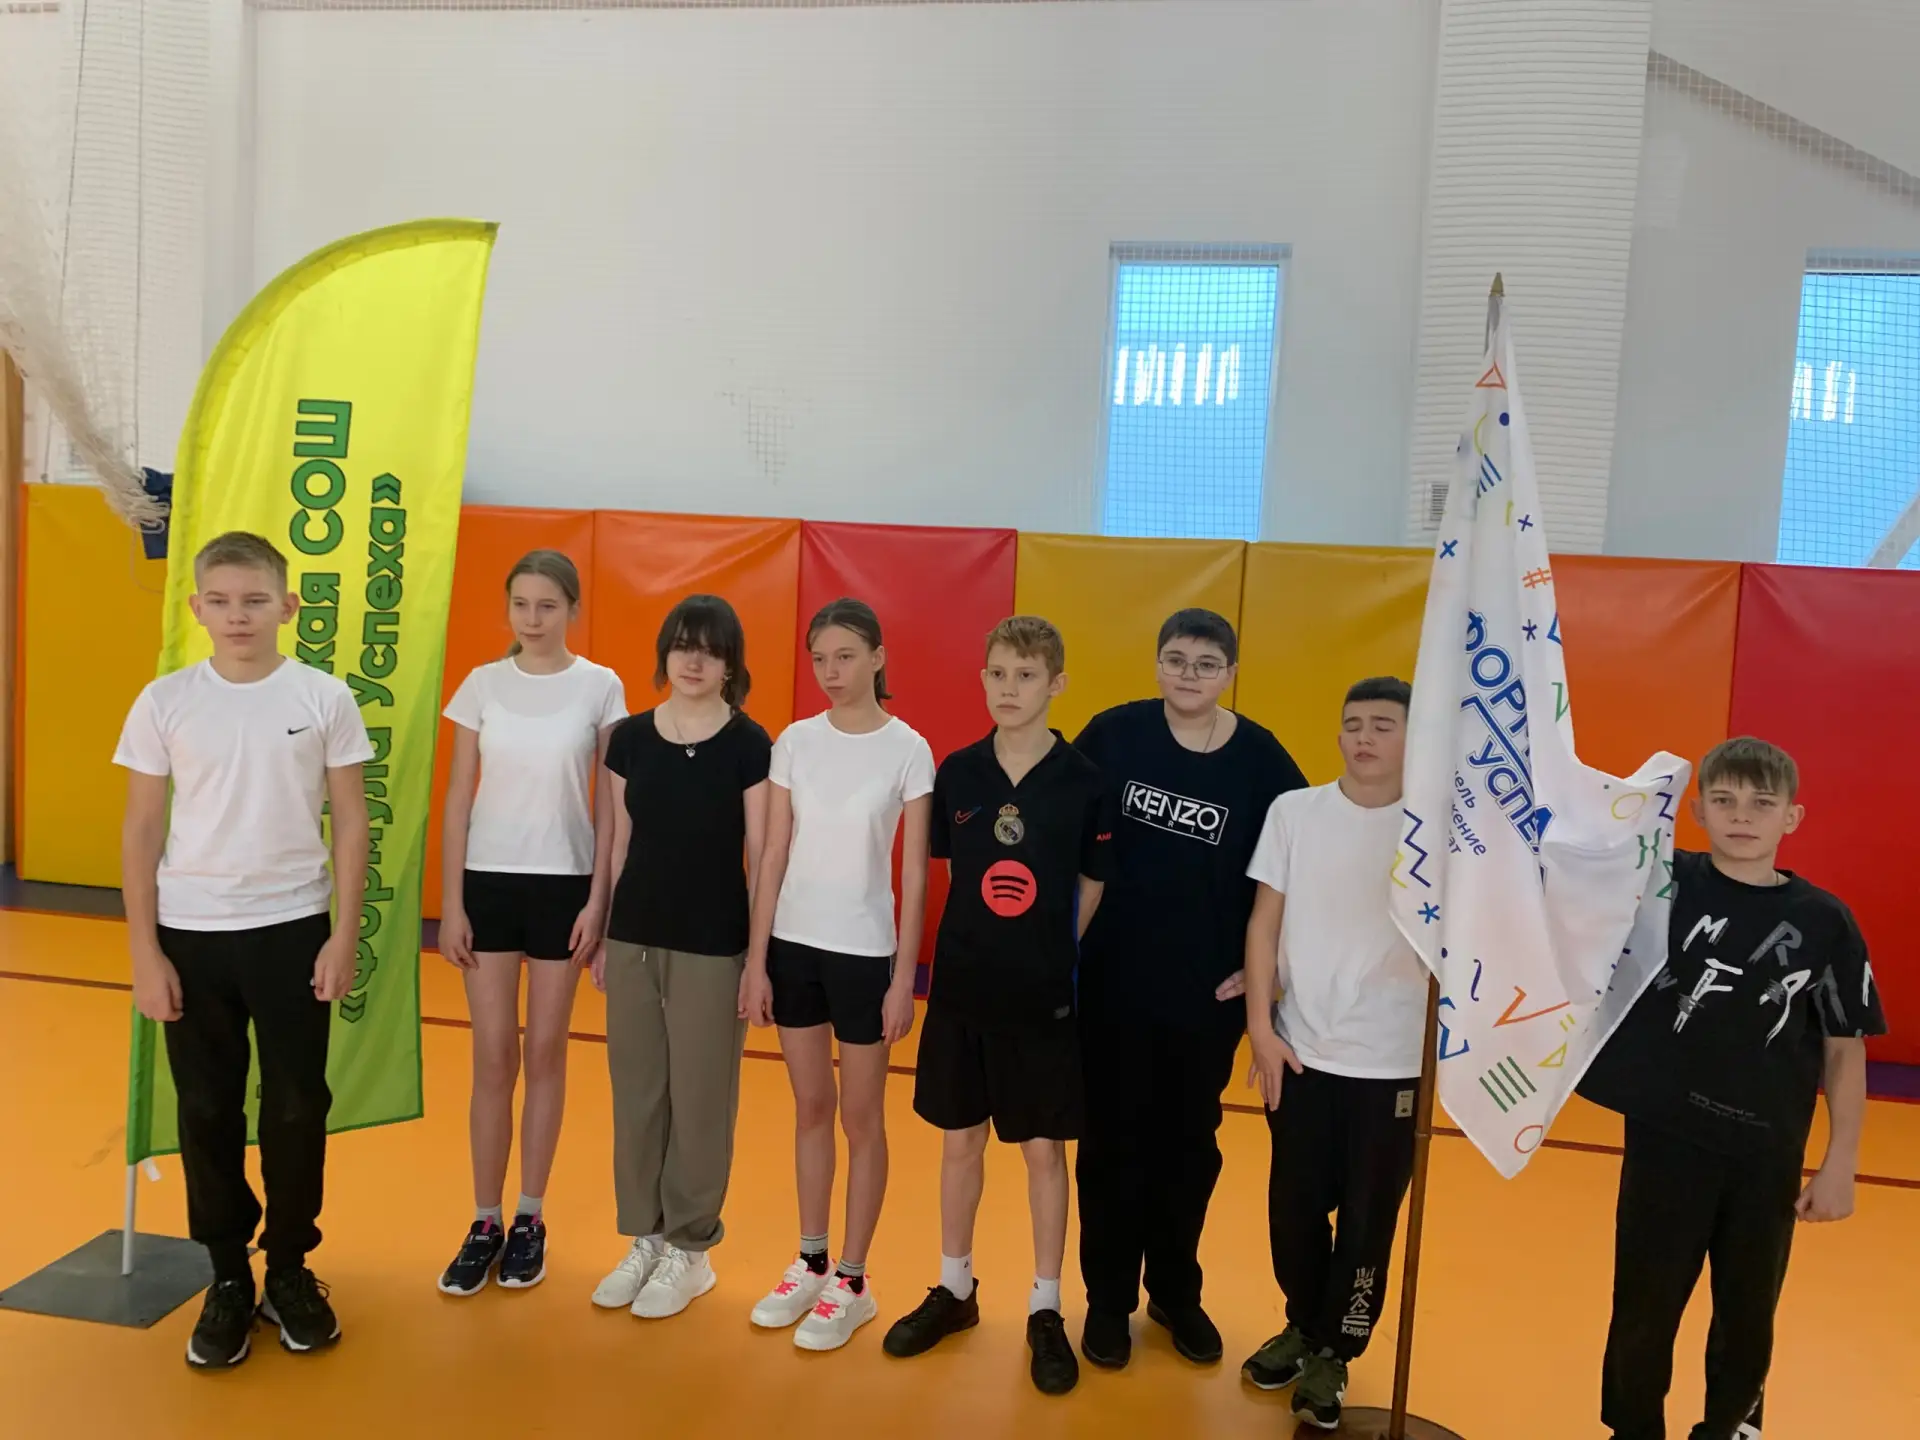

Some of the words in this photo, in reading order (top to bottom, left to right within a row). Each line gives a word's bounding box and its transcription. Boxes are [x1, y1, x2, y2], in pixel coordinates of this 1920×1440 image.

[290, 398, 353, 556] СОШ
[296, 572, 341, 675] кая
[346, 472, 407, 707] Успеха»
[1126, 784, 1220, 831] KENZO
[1454, 770, 1476, 809] ель
[1467, 738, 1541, 854] УСПЕ
[1341, 1324, 1370, 1338] Kappa
